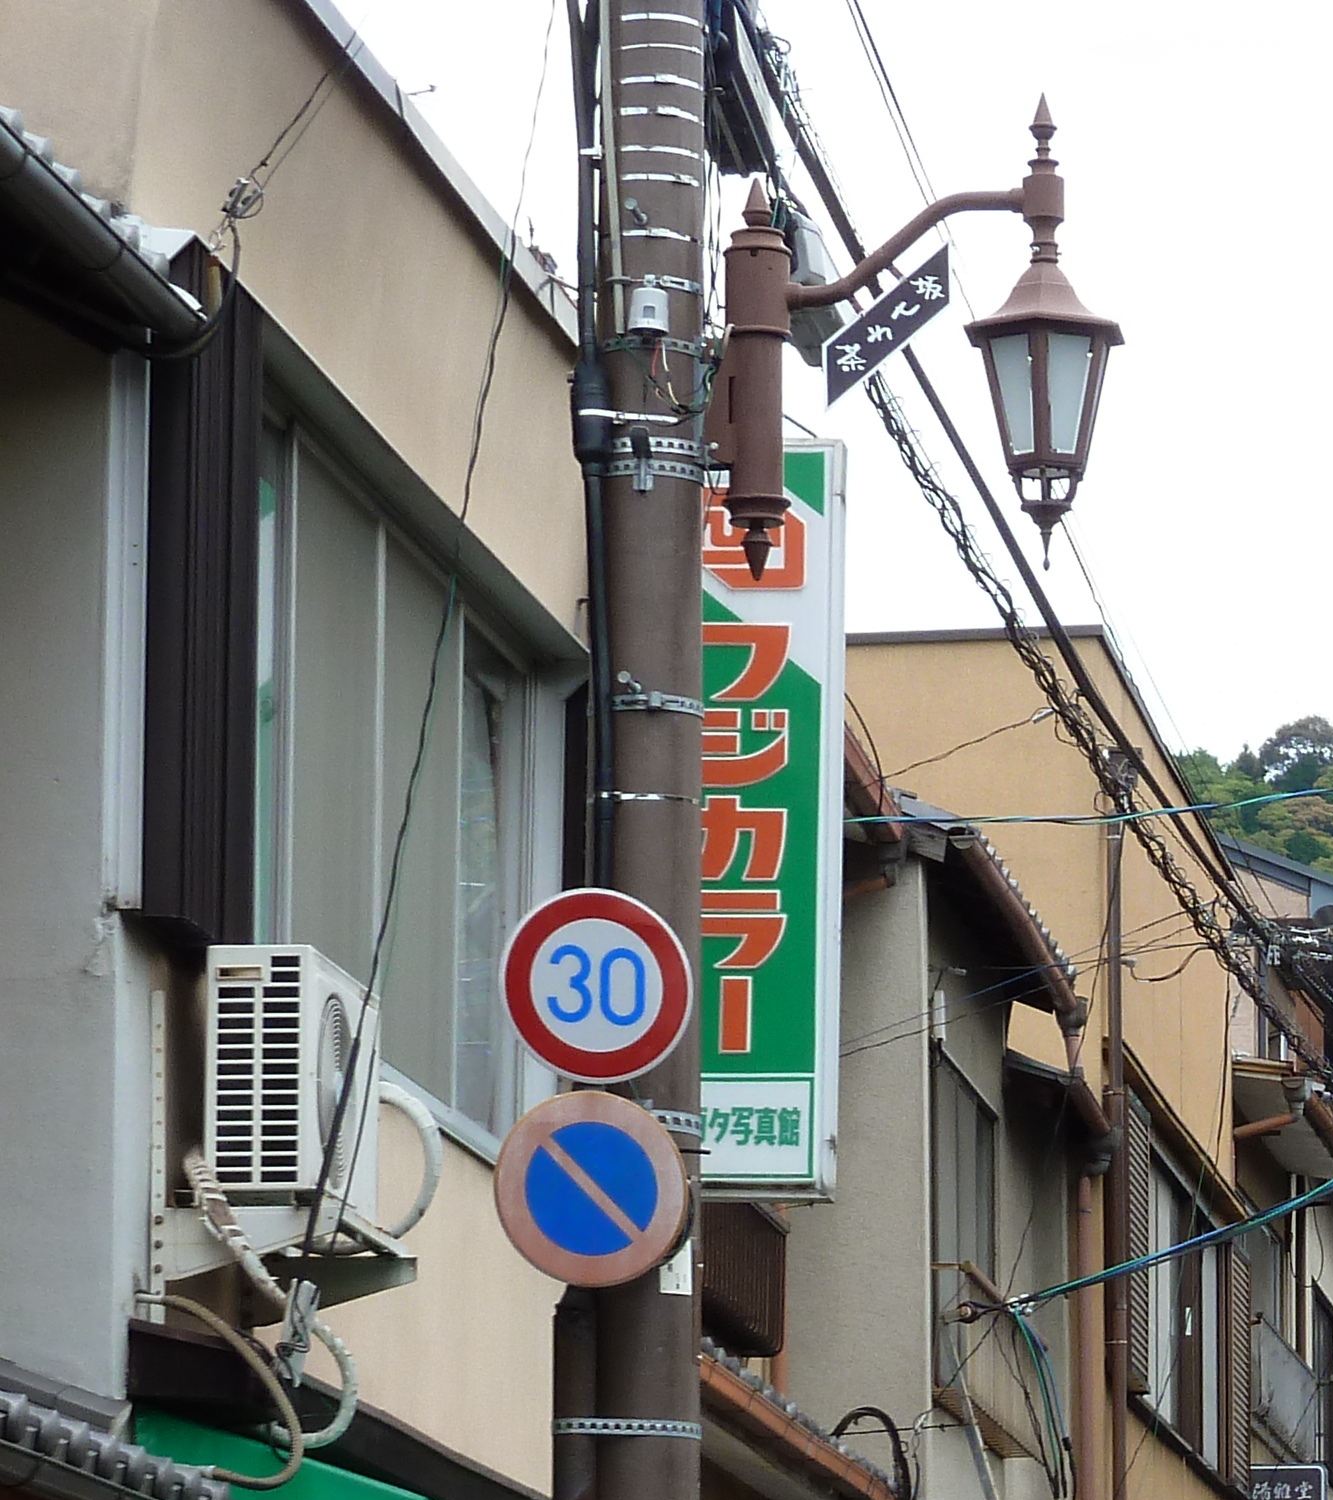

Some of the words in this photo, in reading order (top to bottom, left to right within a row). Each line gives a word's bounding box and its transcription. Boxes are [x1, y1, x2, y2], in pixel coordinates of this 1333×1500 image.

[835, 276, 945, 372] 茶わん坂
[701, 623, 791, 1054] フジカラー
[546, 945, 646, 1026] 30
